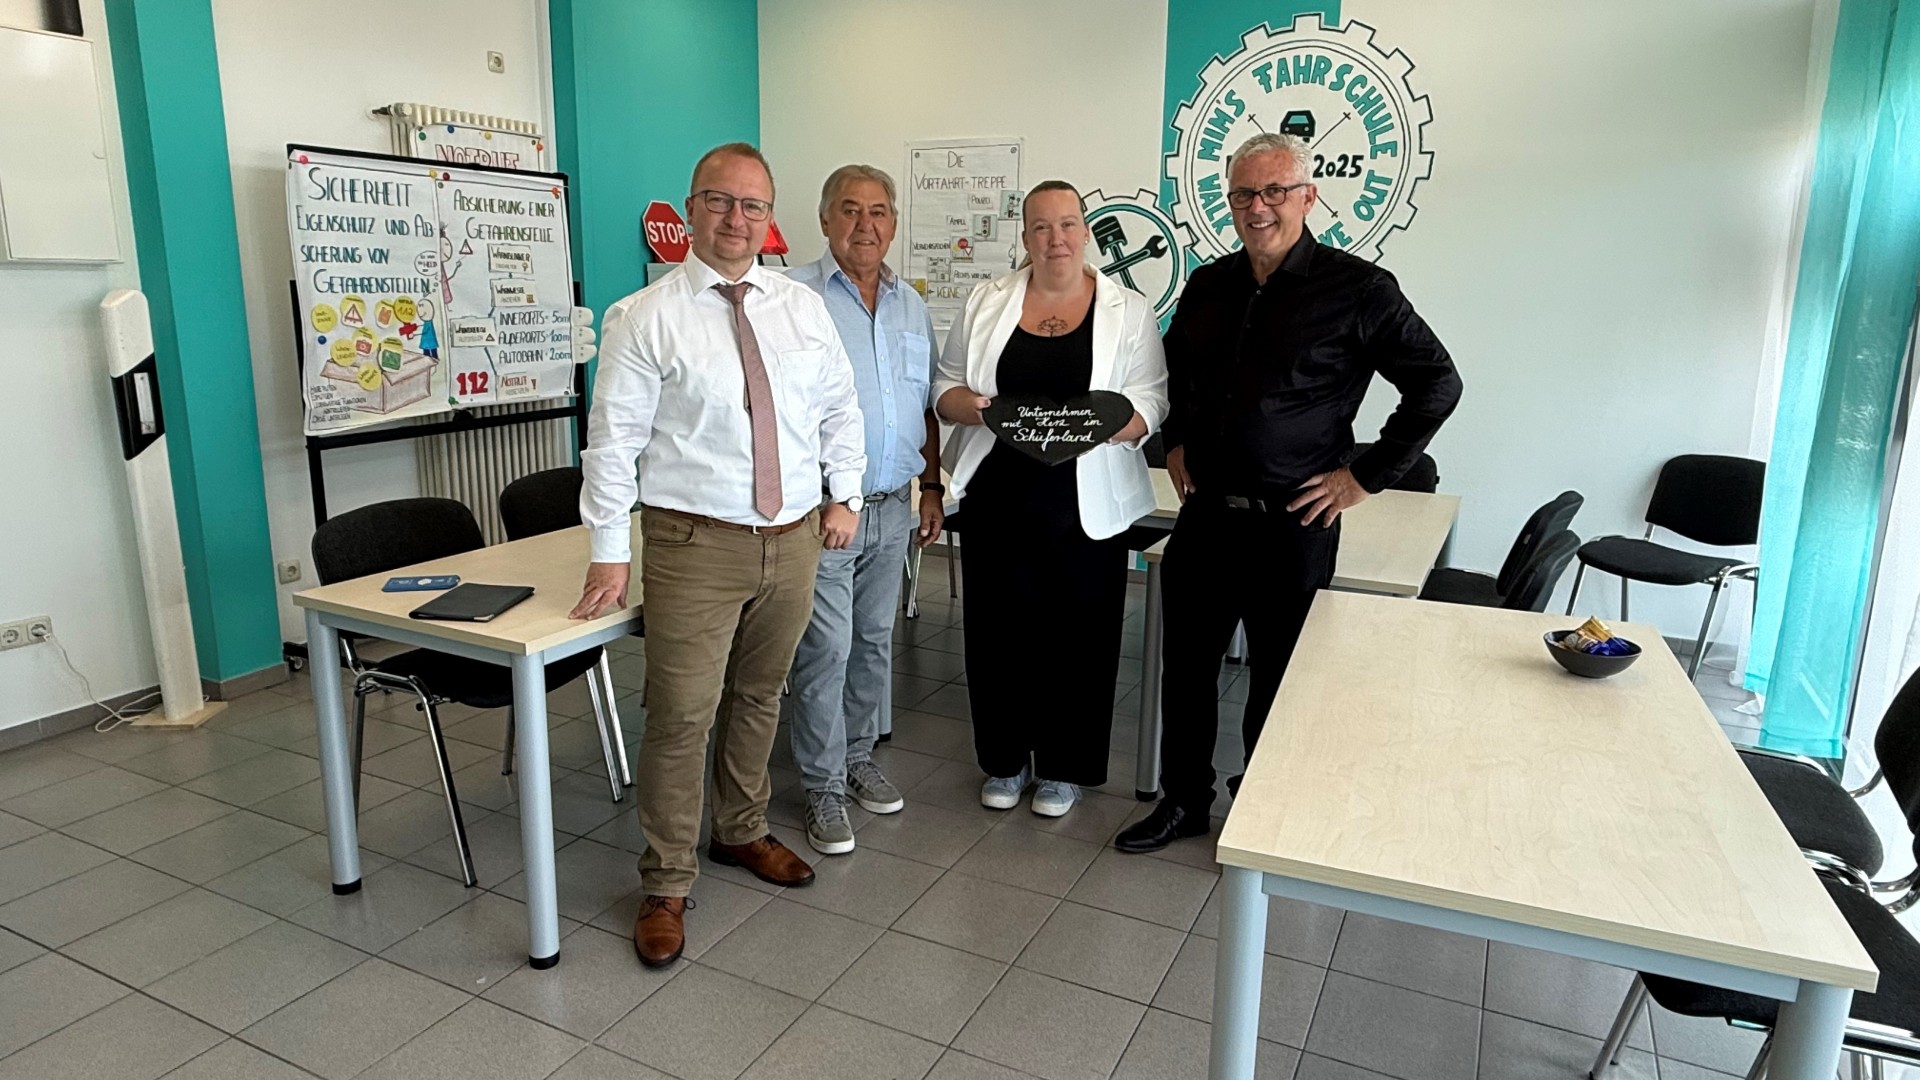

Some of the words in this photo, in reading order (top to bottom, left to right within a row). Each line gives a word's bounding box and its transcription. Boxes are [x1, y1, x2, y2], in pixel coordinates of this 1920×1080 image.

[1252, 54, 1398, 160] FAHRSCHULE
[948, 150, 965, 168] DIE
[308, 167, 413, 207] SICHERHEIT
[454, 189, 525, 215] ABSICHERUNG
[528, 201, 555, 218] EINER
[1197, 173, 1234, 236] WALK
[1353, 169, 1393, 222] OUT
[296, 204, 376, 234] EIGENSCHUTZ
[385, 219, 410, 236] UND
[466, 217, 555, 243] GEFAHRENSTELLE
[647, 220, 686, 245] STOP
[300, 245, 362, 264] SICHERUNG
[367, 248, 391, 265] VON
[313, 268, 431, 294] GEFAHRENSTELLEN
[937, 286, 961, 298] KEINE
[499, 310, 545, 326] INNERORTS
[499, 349, 544, 364] AUTOBAHN
[456, 371, 489, 396] 112
[1001, 419, 1023, 428] mit
[1035, 416, 1070, 427] Herz
[1083, 416, 1103, 427] im
[1017, 405, 1096, 418] Unternehmen
[1012, 428, 1095, 452] Schieferland
